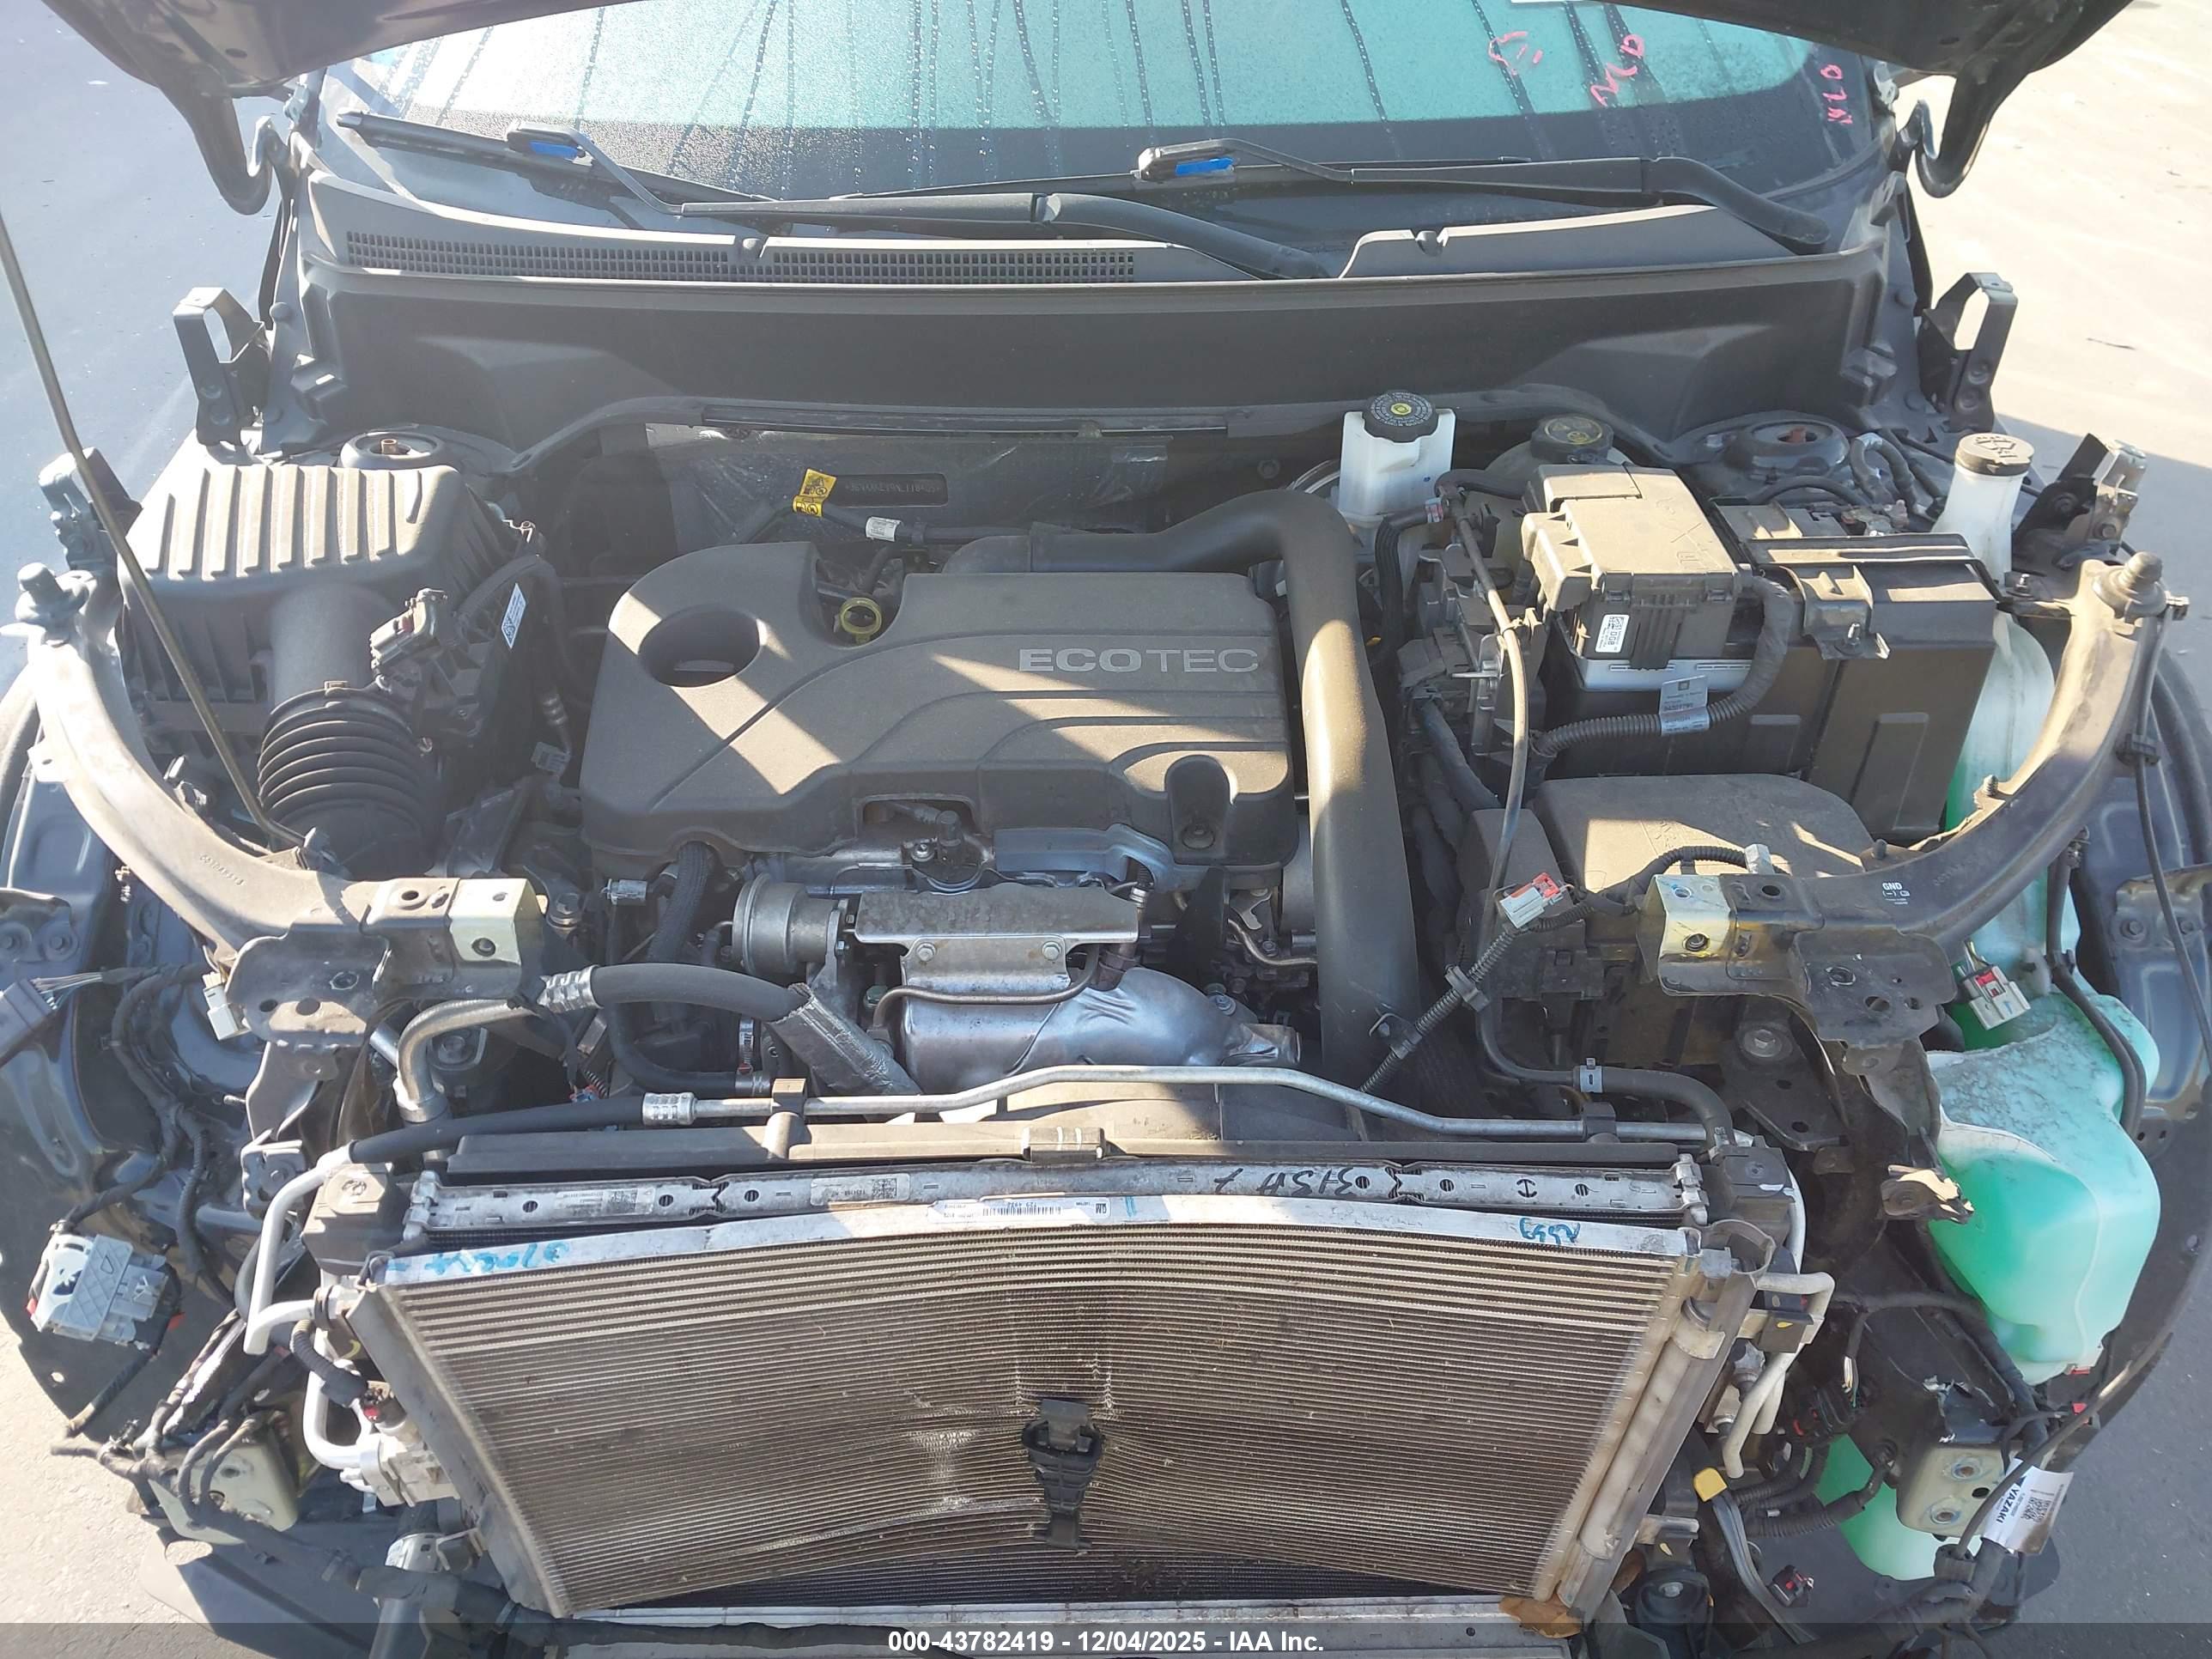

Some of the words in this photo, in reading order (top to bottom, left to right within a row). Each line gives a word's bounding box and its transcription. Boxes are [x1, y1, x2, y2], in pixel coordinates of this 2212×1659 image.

[1019, 648, 1259, 672] ECOTEC
[1882, 882, 1903, 890] GND
[1996, 1488, 2021, 1523] YAZAKI
